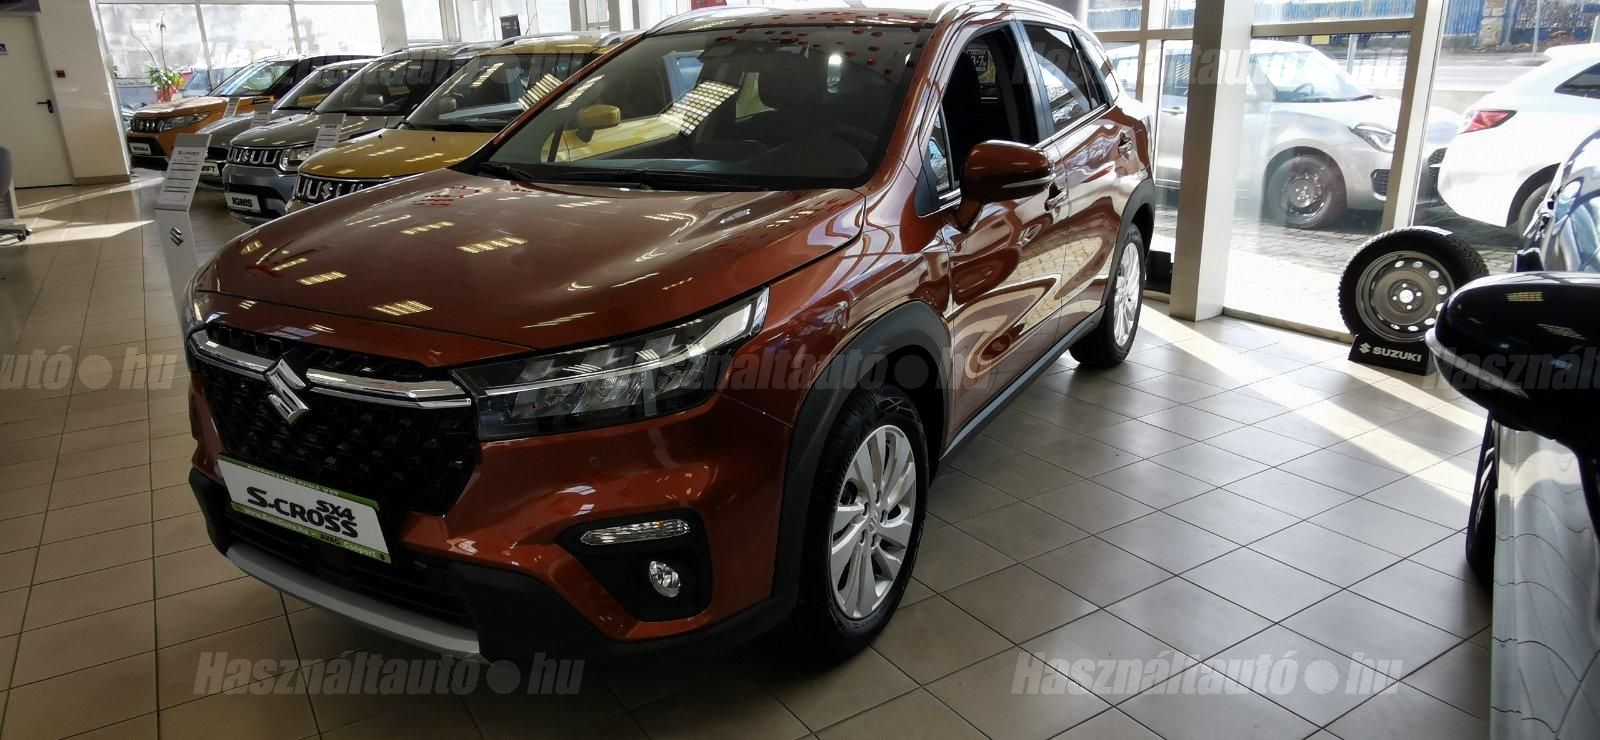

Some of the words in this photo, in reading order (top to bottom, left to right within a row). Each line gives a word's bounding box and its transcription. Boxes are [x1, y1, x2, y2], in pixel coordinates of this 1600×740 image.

[232, 196, 253, 208] IGNIS
[1372, 346, 1422, 362] SUZUKI
[246, 486, 358, 539] S-CROSS
[316, 500, 356, 521] SX4
[343, 541, 376, 558] Csoport
